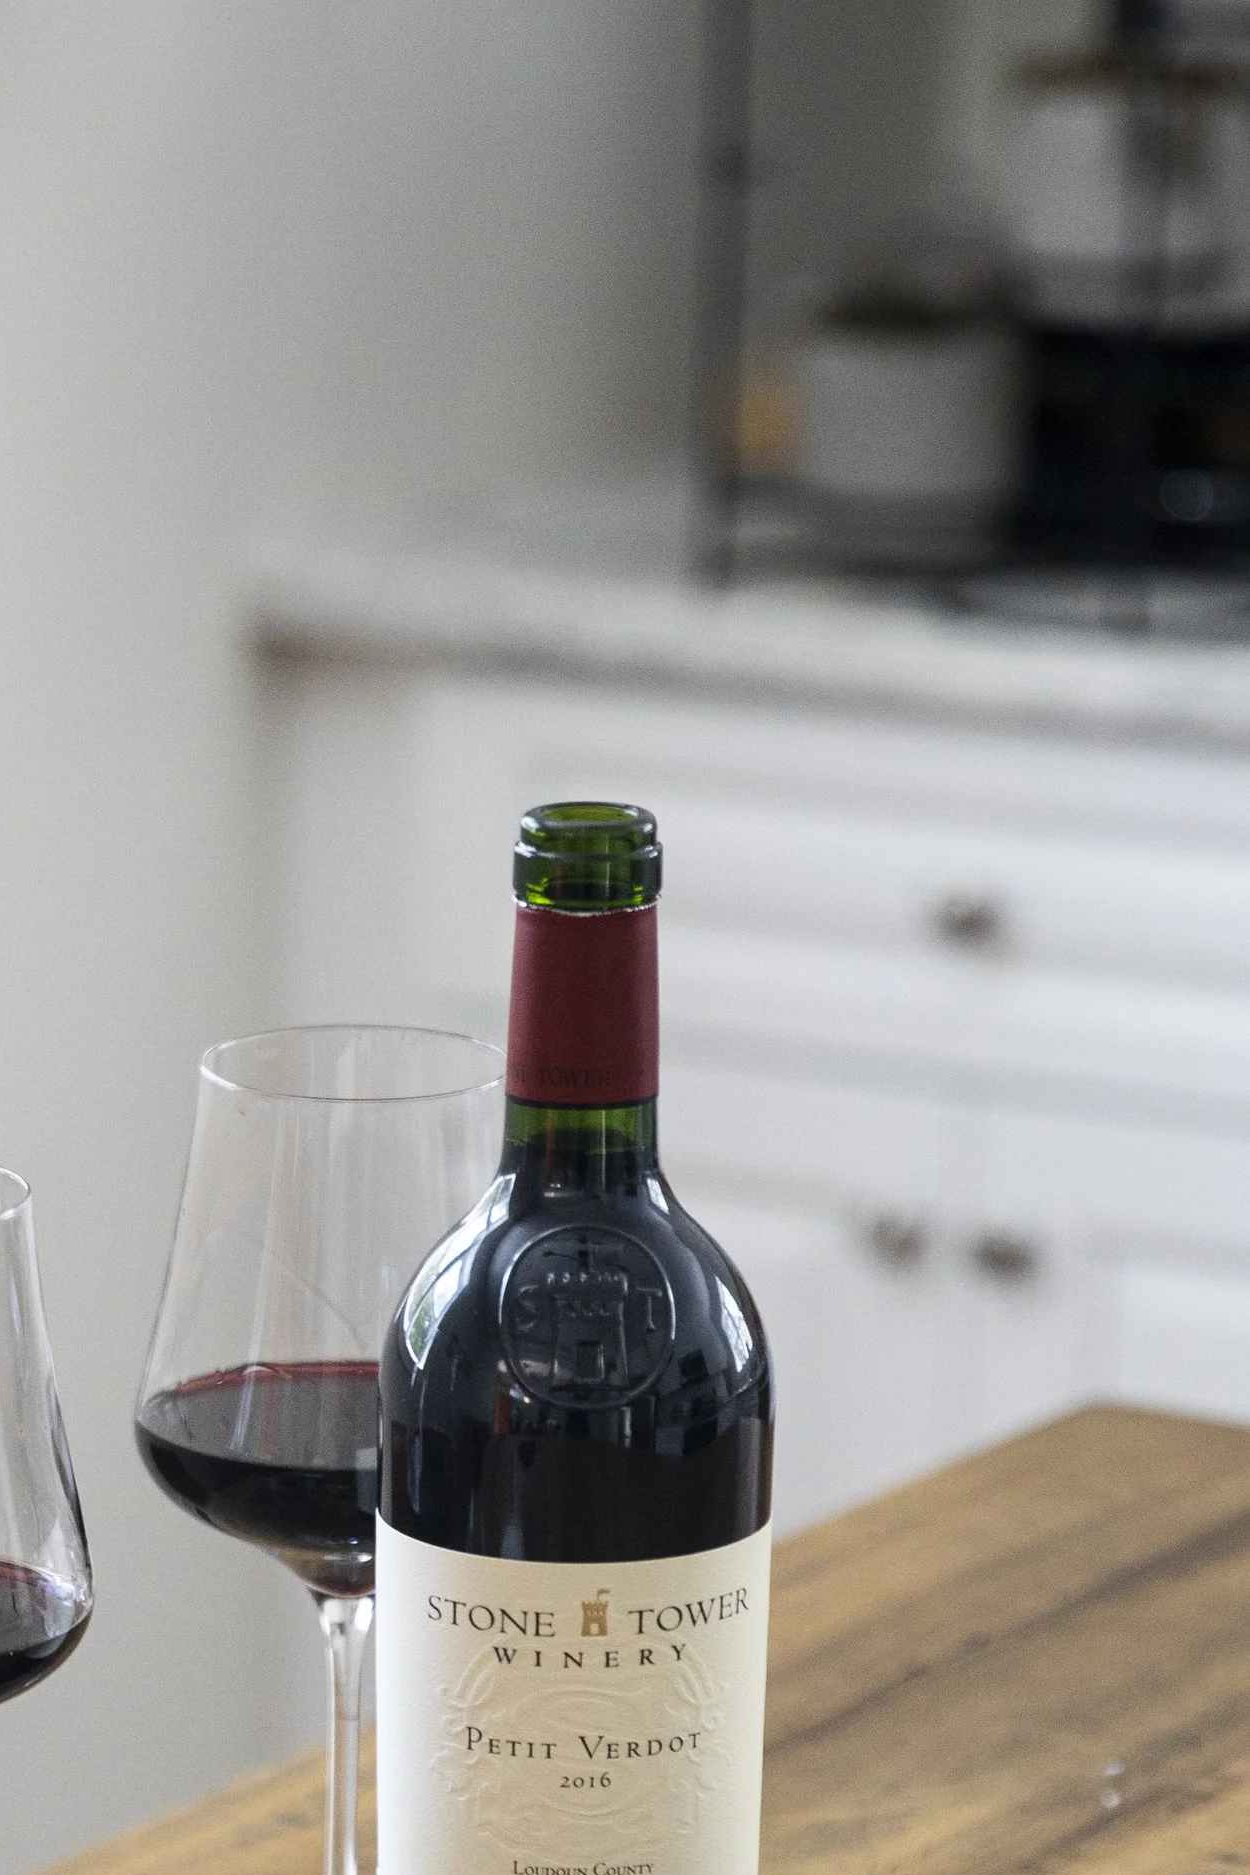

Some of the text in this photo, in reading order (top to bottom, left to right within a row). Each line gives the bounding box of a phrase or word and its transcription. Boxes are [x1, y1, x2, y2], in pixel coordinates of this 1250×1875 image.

[427, 1587, 750, 1638] STONE TOWER
[492, 1643, 687, 1668] WINERY
[465, 1726, 703, 1760] PETIT VERDOT
[559, 1772, 612, 1789] 2016
